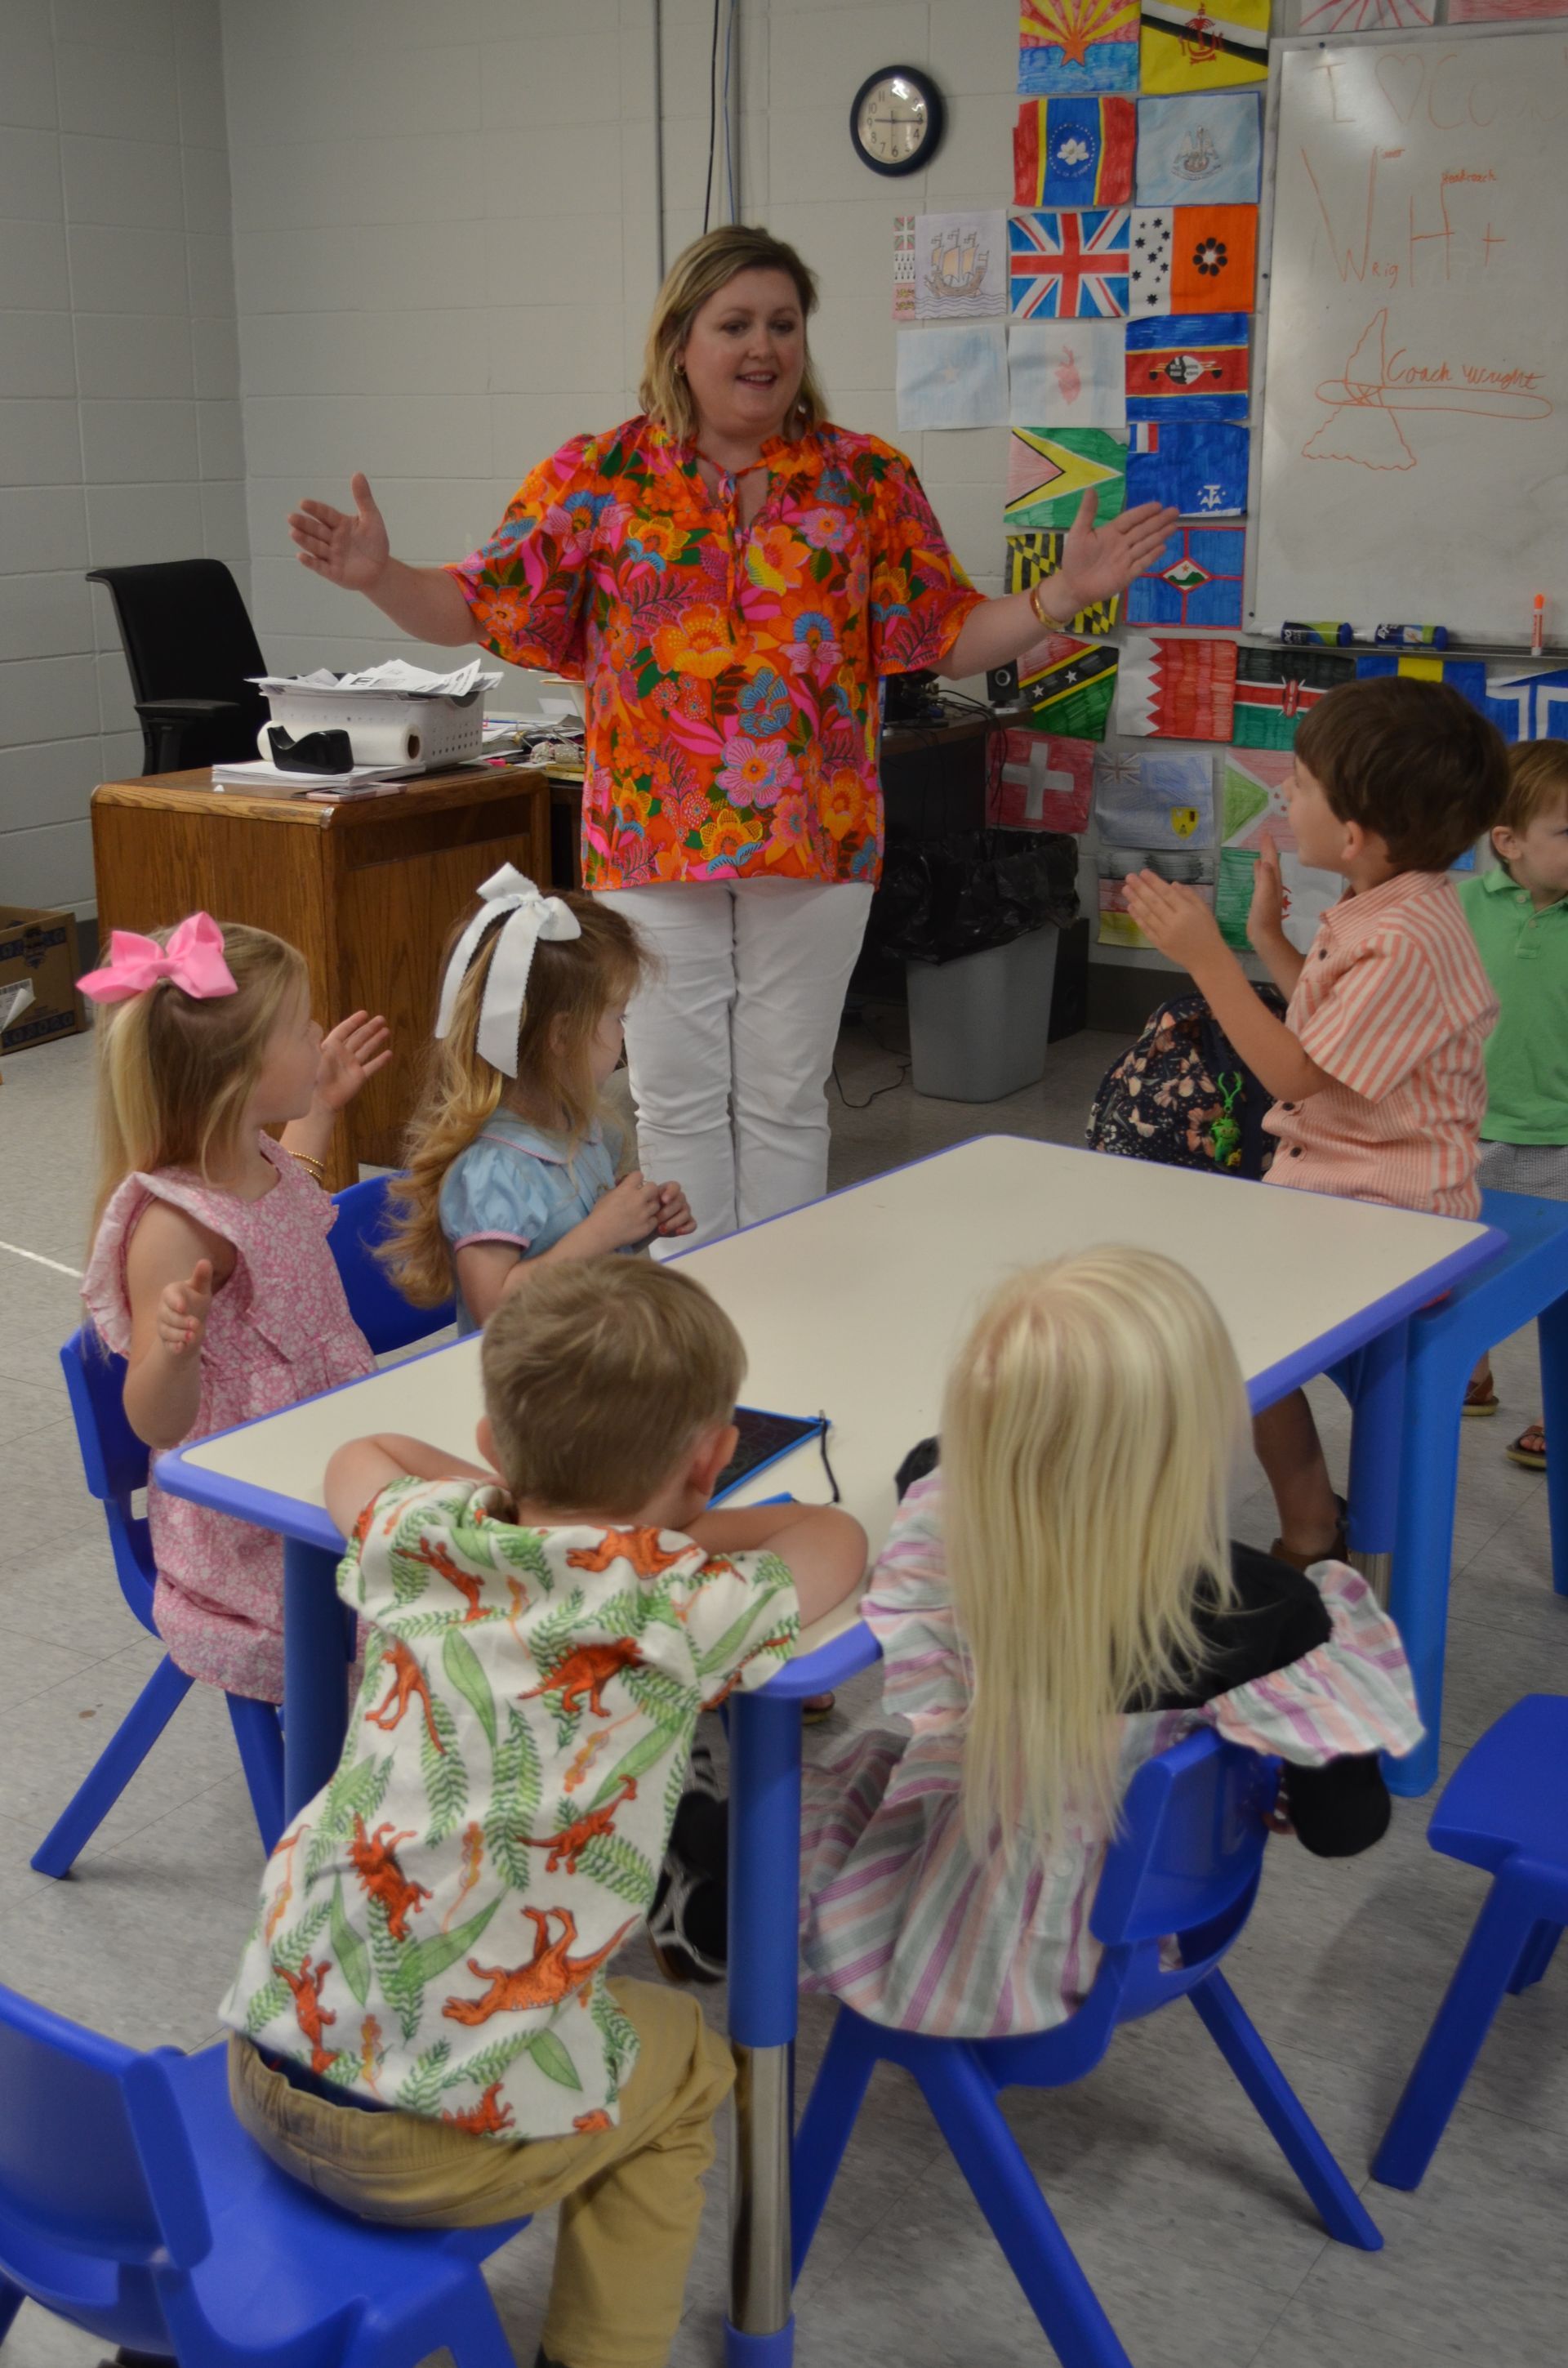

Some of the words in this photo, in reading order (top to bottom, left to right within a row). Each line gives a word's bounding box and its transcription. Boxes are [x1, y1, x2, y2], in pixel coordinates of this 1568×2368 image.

[868, 103, 877, 114] 10
[866, 118, 873, 129] 9
[917, 112, 924, 125] 3
[871, 132, 877, 144] 8
[913, 128, 920, 140] 4
[880, 142, 886, 154] 7
[892, 145, 898, 157] 6
[1387, 348, 1453, 384] Coach
